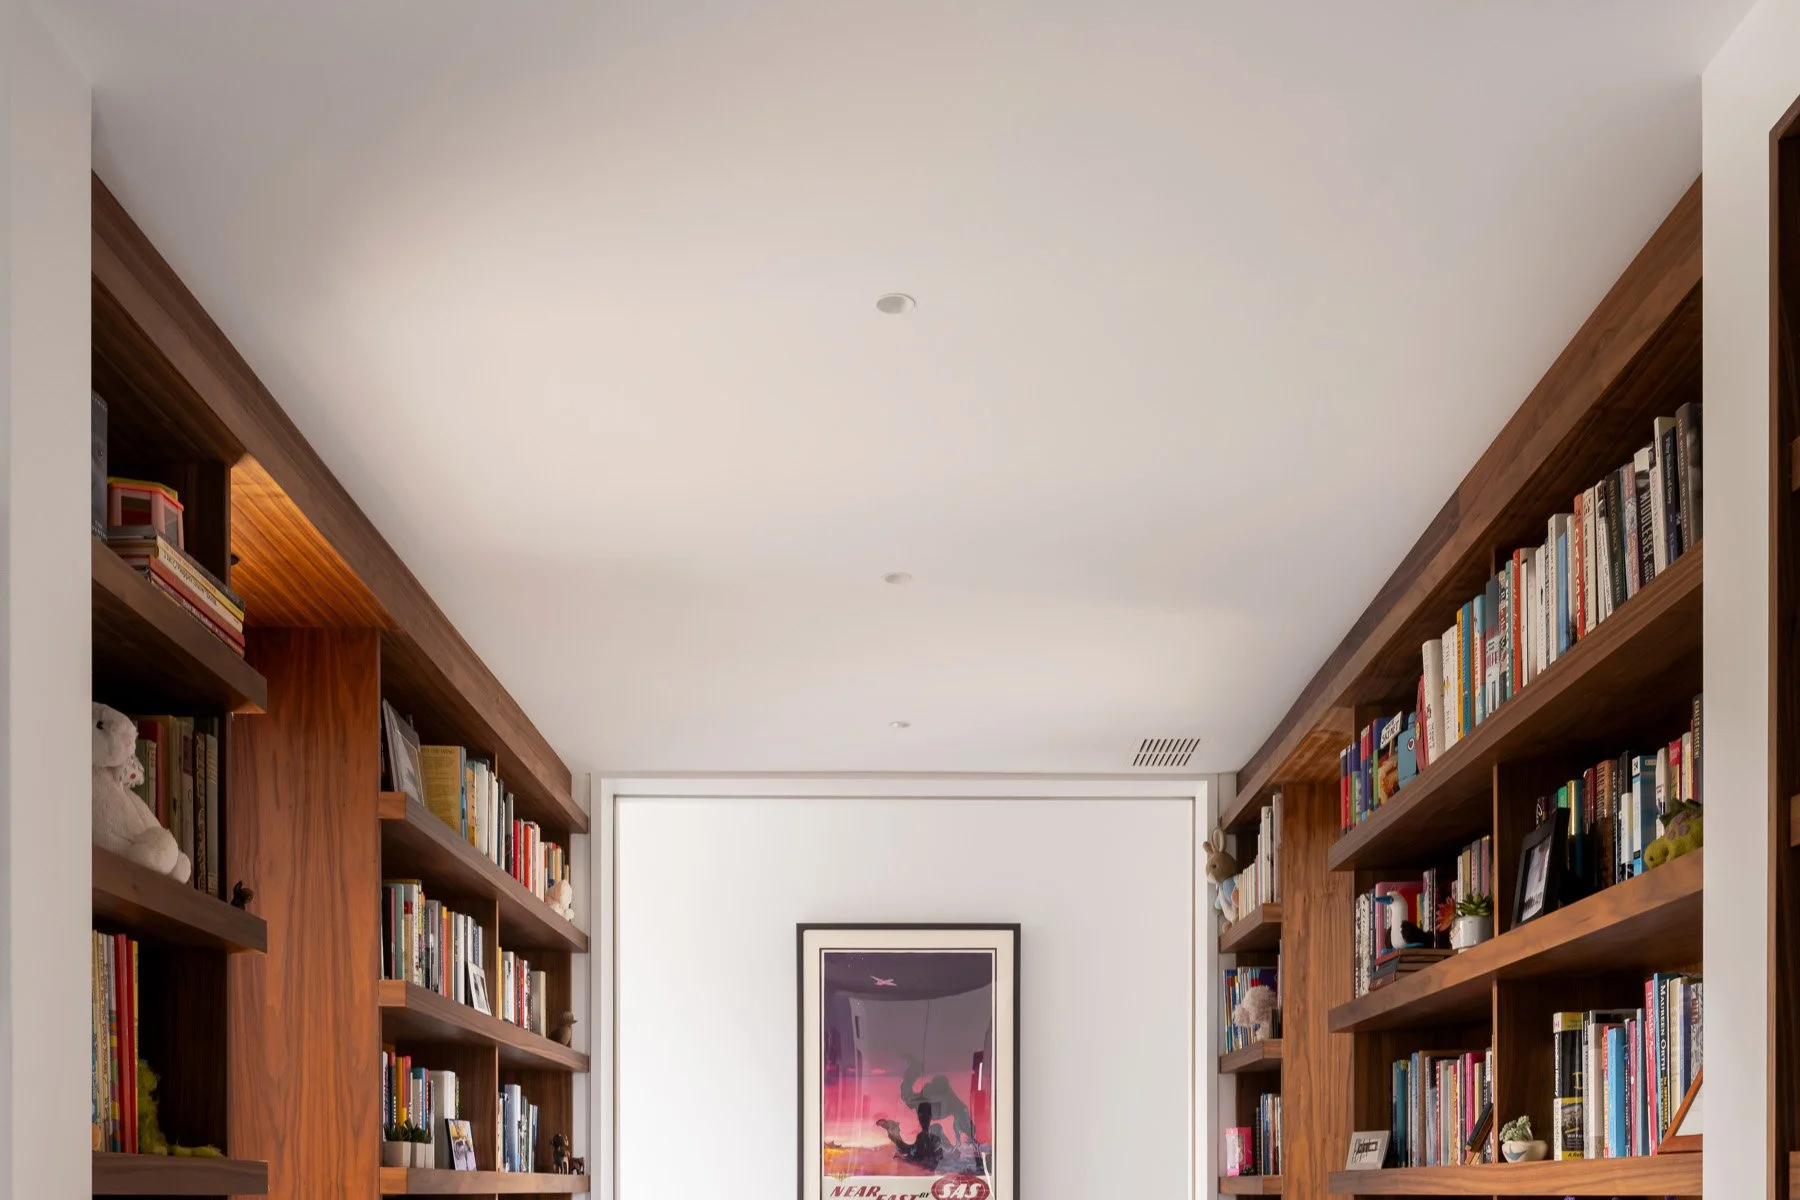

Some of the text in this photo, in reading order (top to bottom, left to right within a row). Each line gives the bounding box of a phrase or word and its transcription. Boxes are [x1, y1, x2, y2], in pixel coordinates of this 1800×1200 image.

[1639, 491, 1653, 560] MIDDLESEX
[1596, 766, 1604, 823] DAN BROWN
[830, 1186, 881, 1197] NEAR
[938, 1183, 981, 1199] SAS
